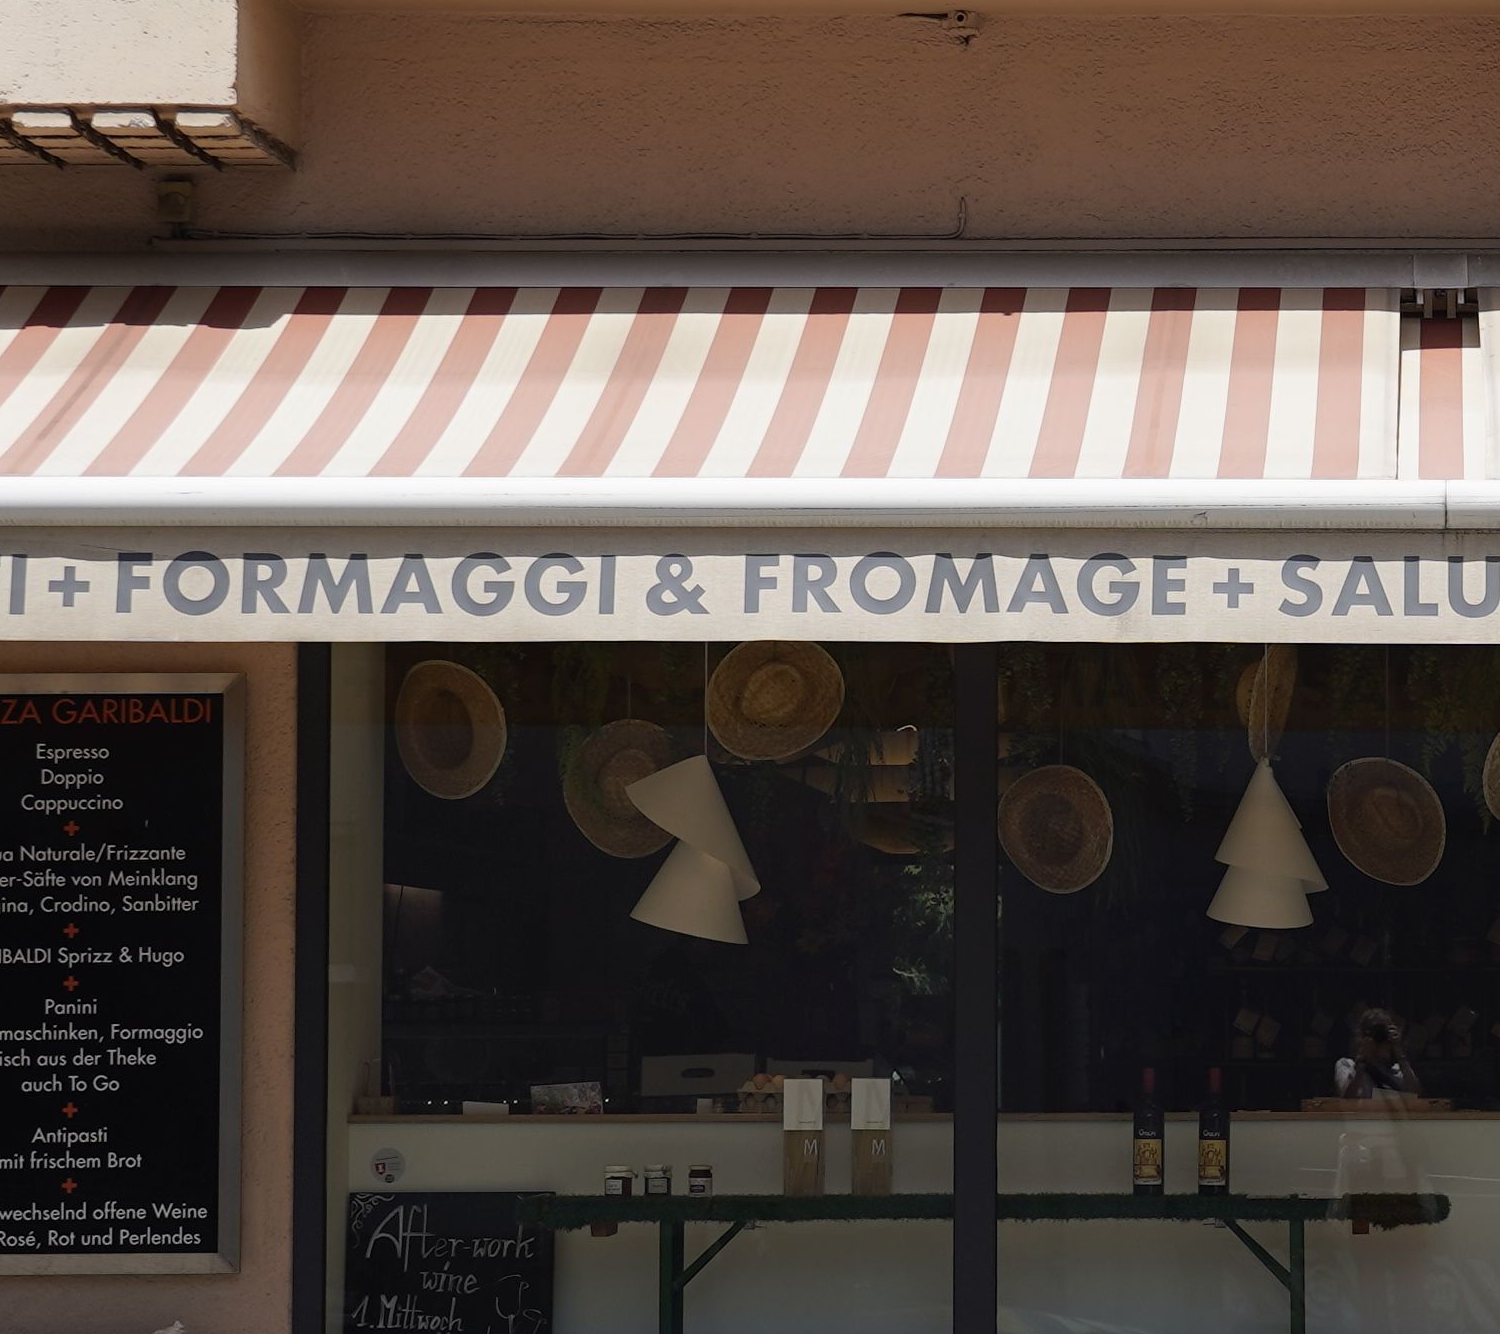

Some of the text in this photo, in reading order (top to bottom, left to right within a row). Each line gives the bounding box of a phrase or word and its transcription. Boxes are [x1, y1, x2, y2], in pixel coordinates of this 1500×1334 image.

[117, 553, 614, 615] FORMAGGI
[745, 552, 1187, 615] FROMAGE
[51, 698, 212, 725] GARIBALDI
[36, 743, 110, 765] Espresso
[40, 768, 105, 790] Doppio
[20, 793, 124, 816] Cappuccino
[20, 842, 186, 863] Naturale/Frizzante
[70, 875, 102, 887] von
[107, 867, 198, 891] Meinklang
[40, 893, 116, 915] Crodino,
[121, 893, 200, 912] Sanbitter
[44, 998, 98, 1015] Panini
[110, 1023, 204, 1045] Formaggio
[31, 1126, 108, 1148] Antipasti
[92, 1200, 147, 1220] offene
[151, 1202, 208, 1220] Weine
[48, 1229, 76, 1246] Rot
[81, 1226, 113, 1246] und
[119, 1226, 202, 1246] Perlendes
[419, 1261, 480, 1294] wine
